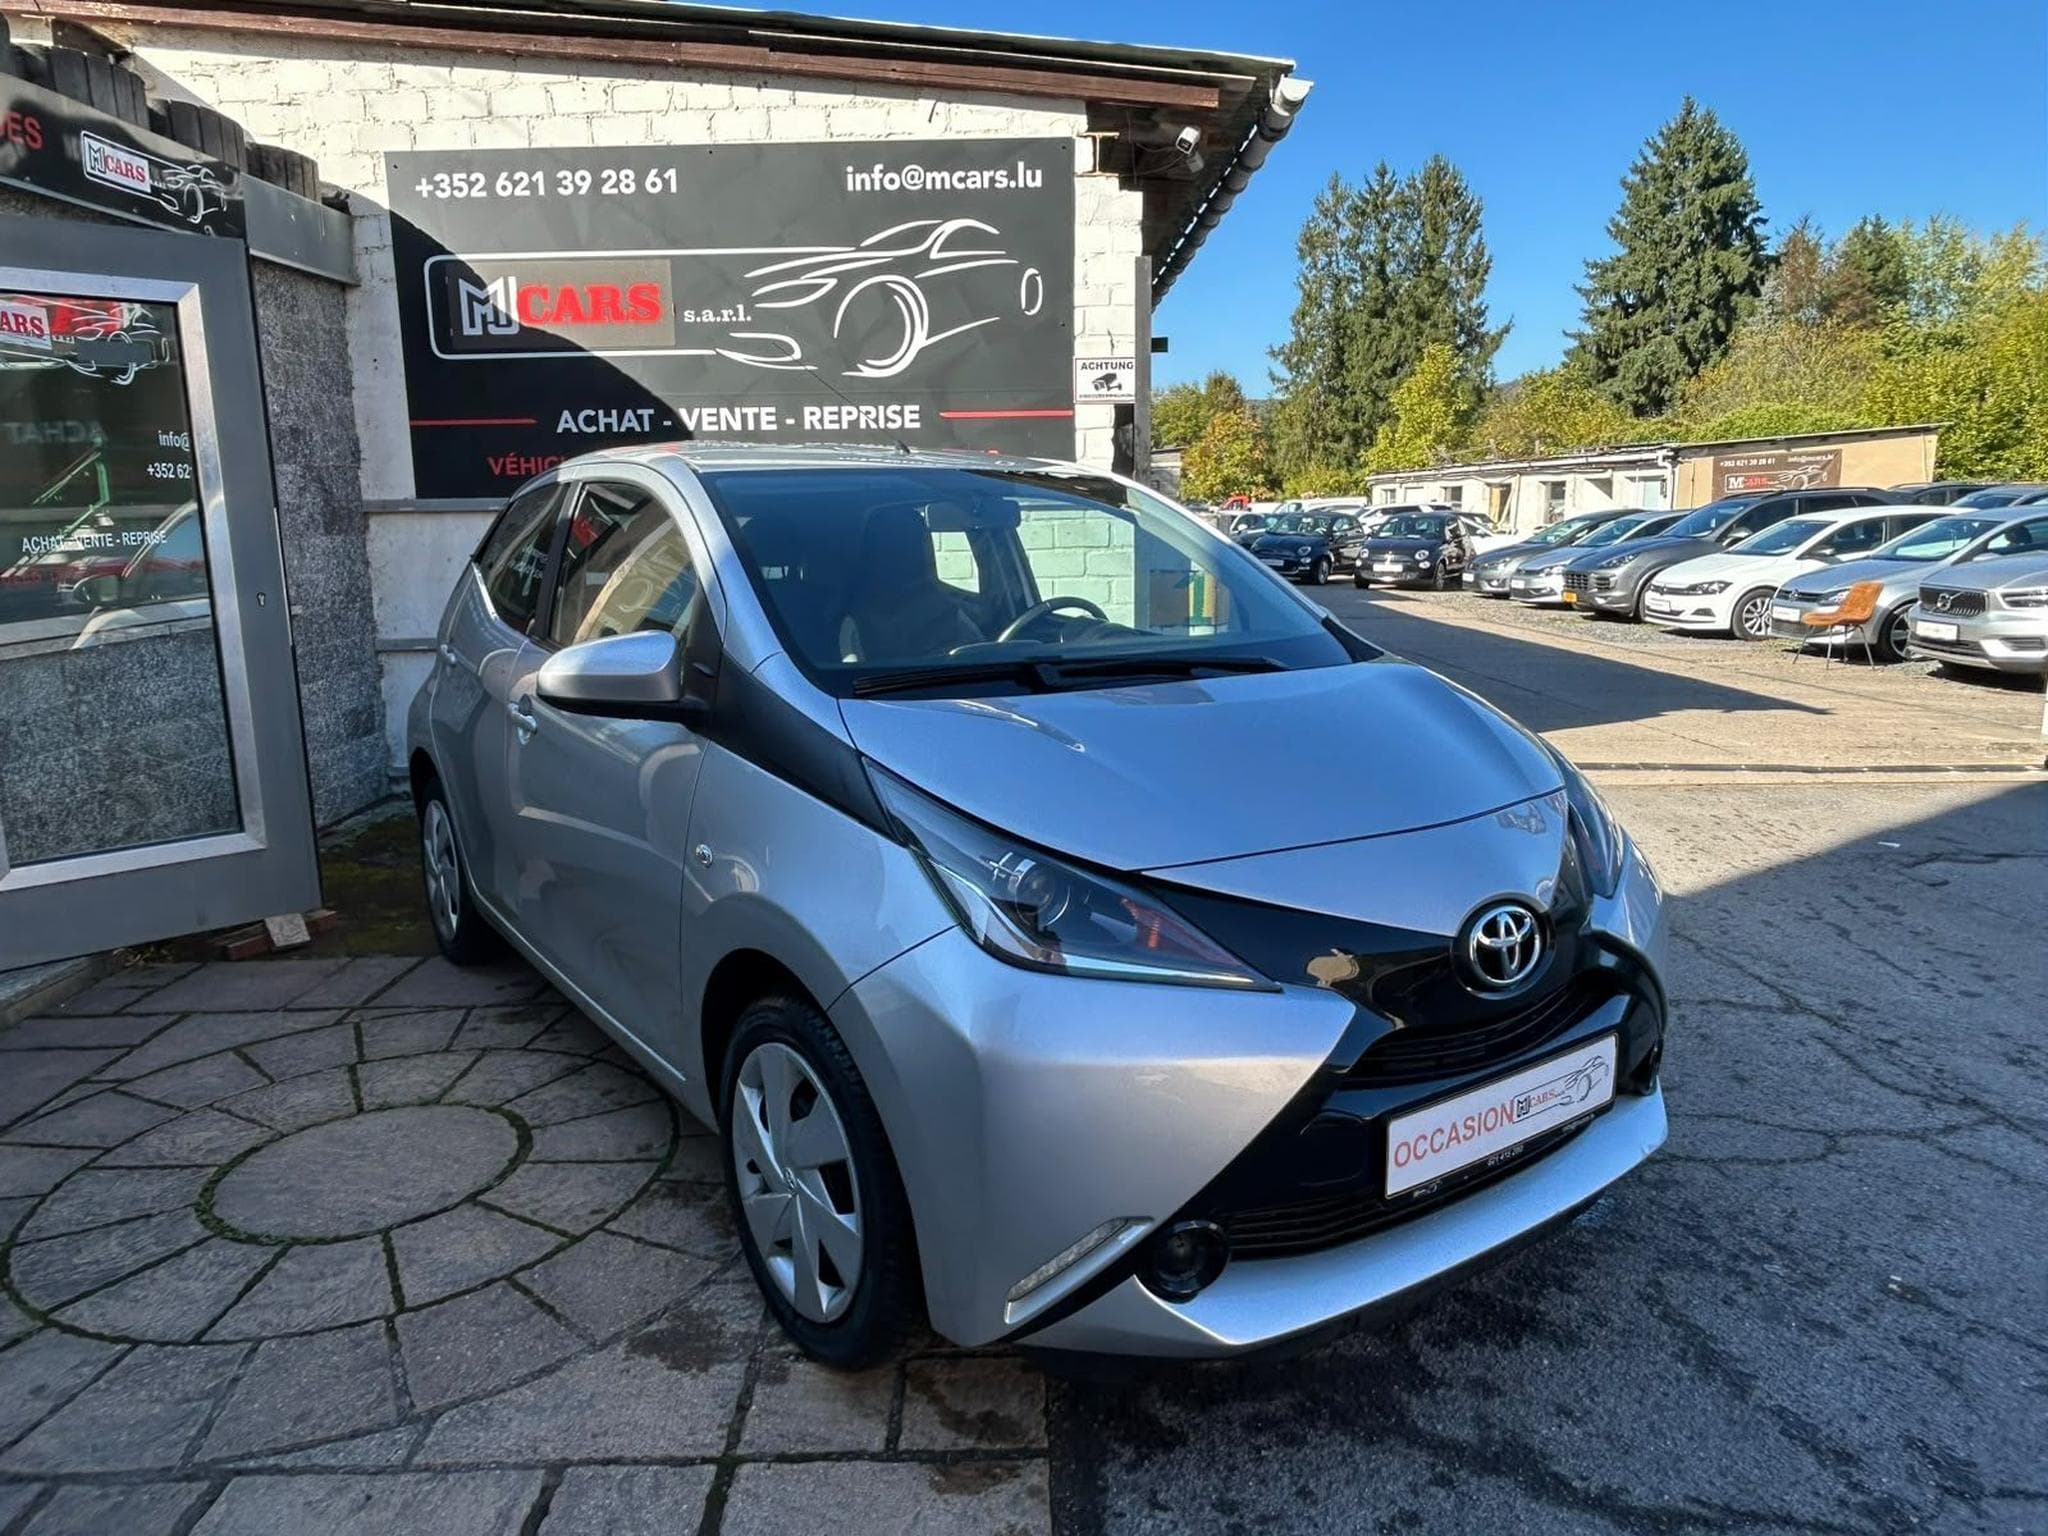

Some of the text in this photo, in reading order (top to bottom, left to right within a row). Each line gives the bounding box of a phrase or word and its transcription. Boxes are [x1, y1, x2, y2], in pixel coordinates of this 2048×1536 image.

[415, 168, 677, 198] +352 621 39 28 61
[845, 160, 1043, 192] info@mcars.lu
[1080, 361, 1134, 371] ACHTUNG
[556, 409, 654, 434] ACHAT
[681, 407, 777, 431] VENTE
[804, 404, 921, 430] REPRISE
[147, 463, 175, 479] +352
[486, 451, 565, 476] VÉHIC
[22, 535, 65, 554] ACHAT
[77, 532, 114, 550] VENTE
[122, 530, 167, 546] REPRISE
[1394, 1099, 1514, 1168] OCCASION
